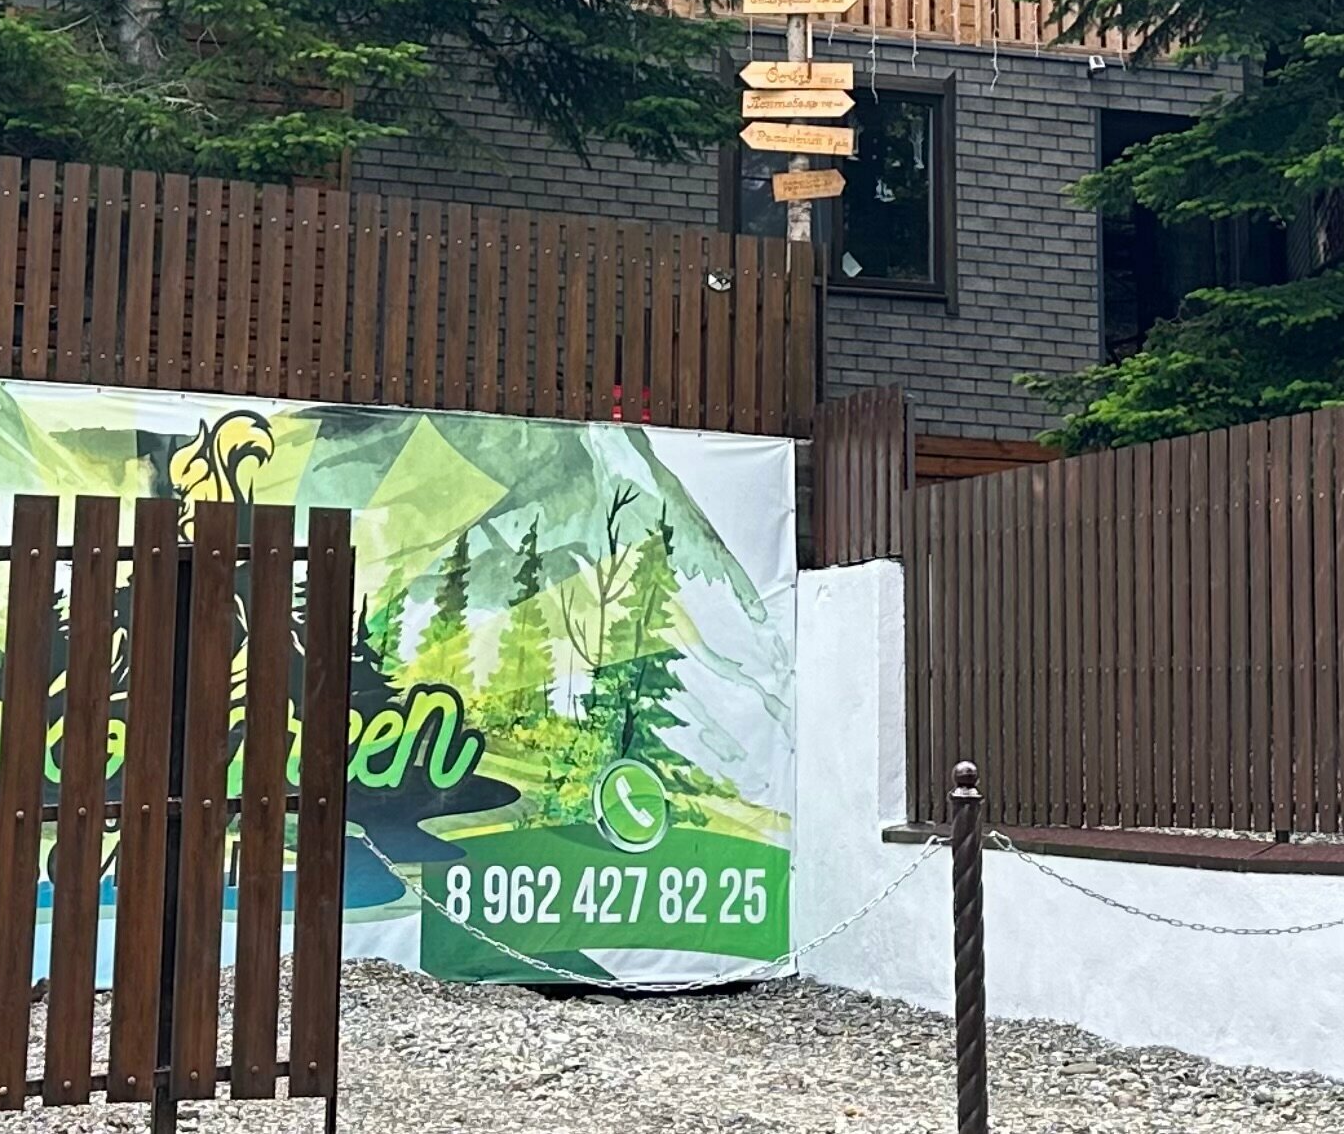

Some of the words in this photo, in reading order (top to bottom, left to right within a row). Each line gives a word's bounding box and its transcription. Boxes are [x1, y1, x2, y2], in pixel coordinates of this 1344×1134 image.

[446, 864, 472, 924] 8
[483, 865, 561, 924] 962
[572, 866, 648, 924] 427
[659, 867, 707, 924] 82
[719, 868, 767, 924] 25
